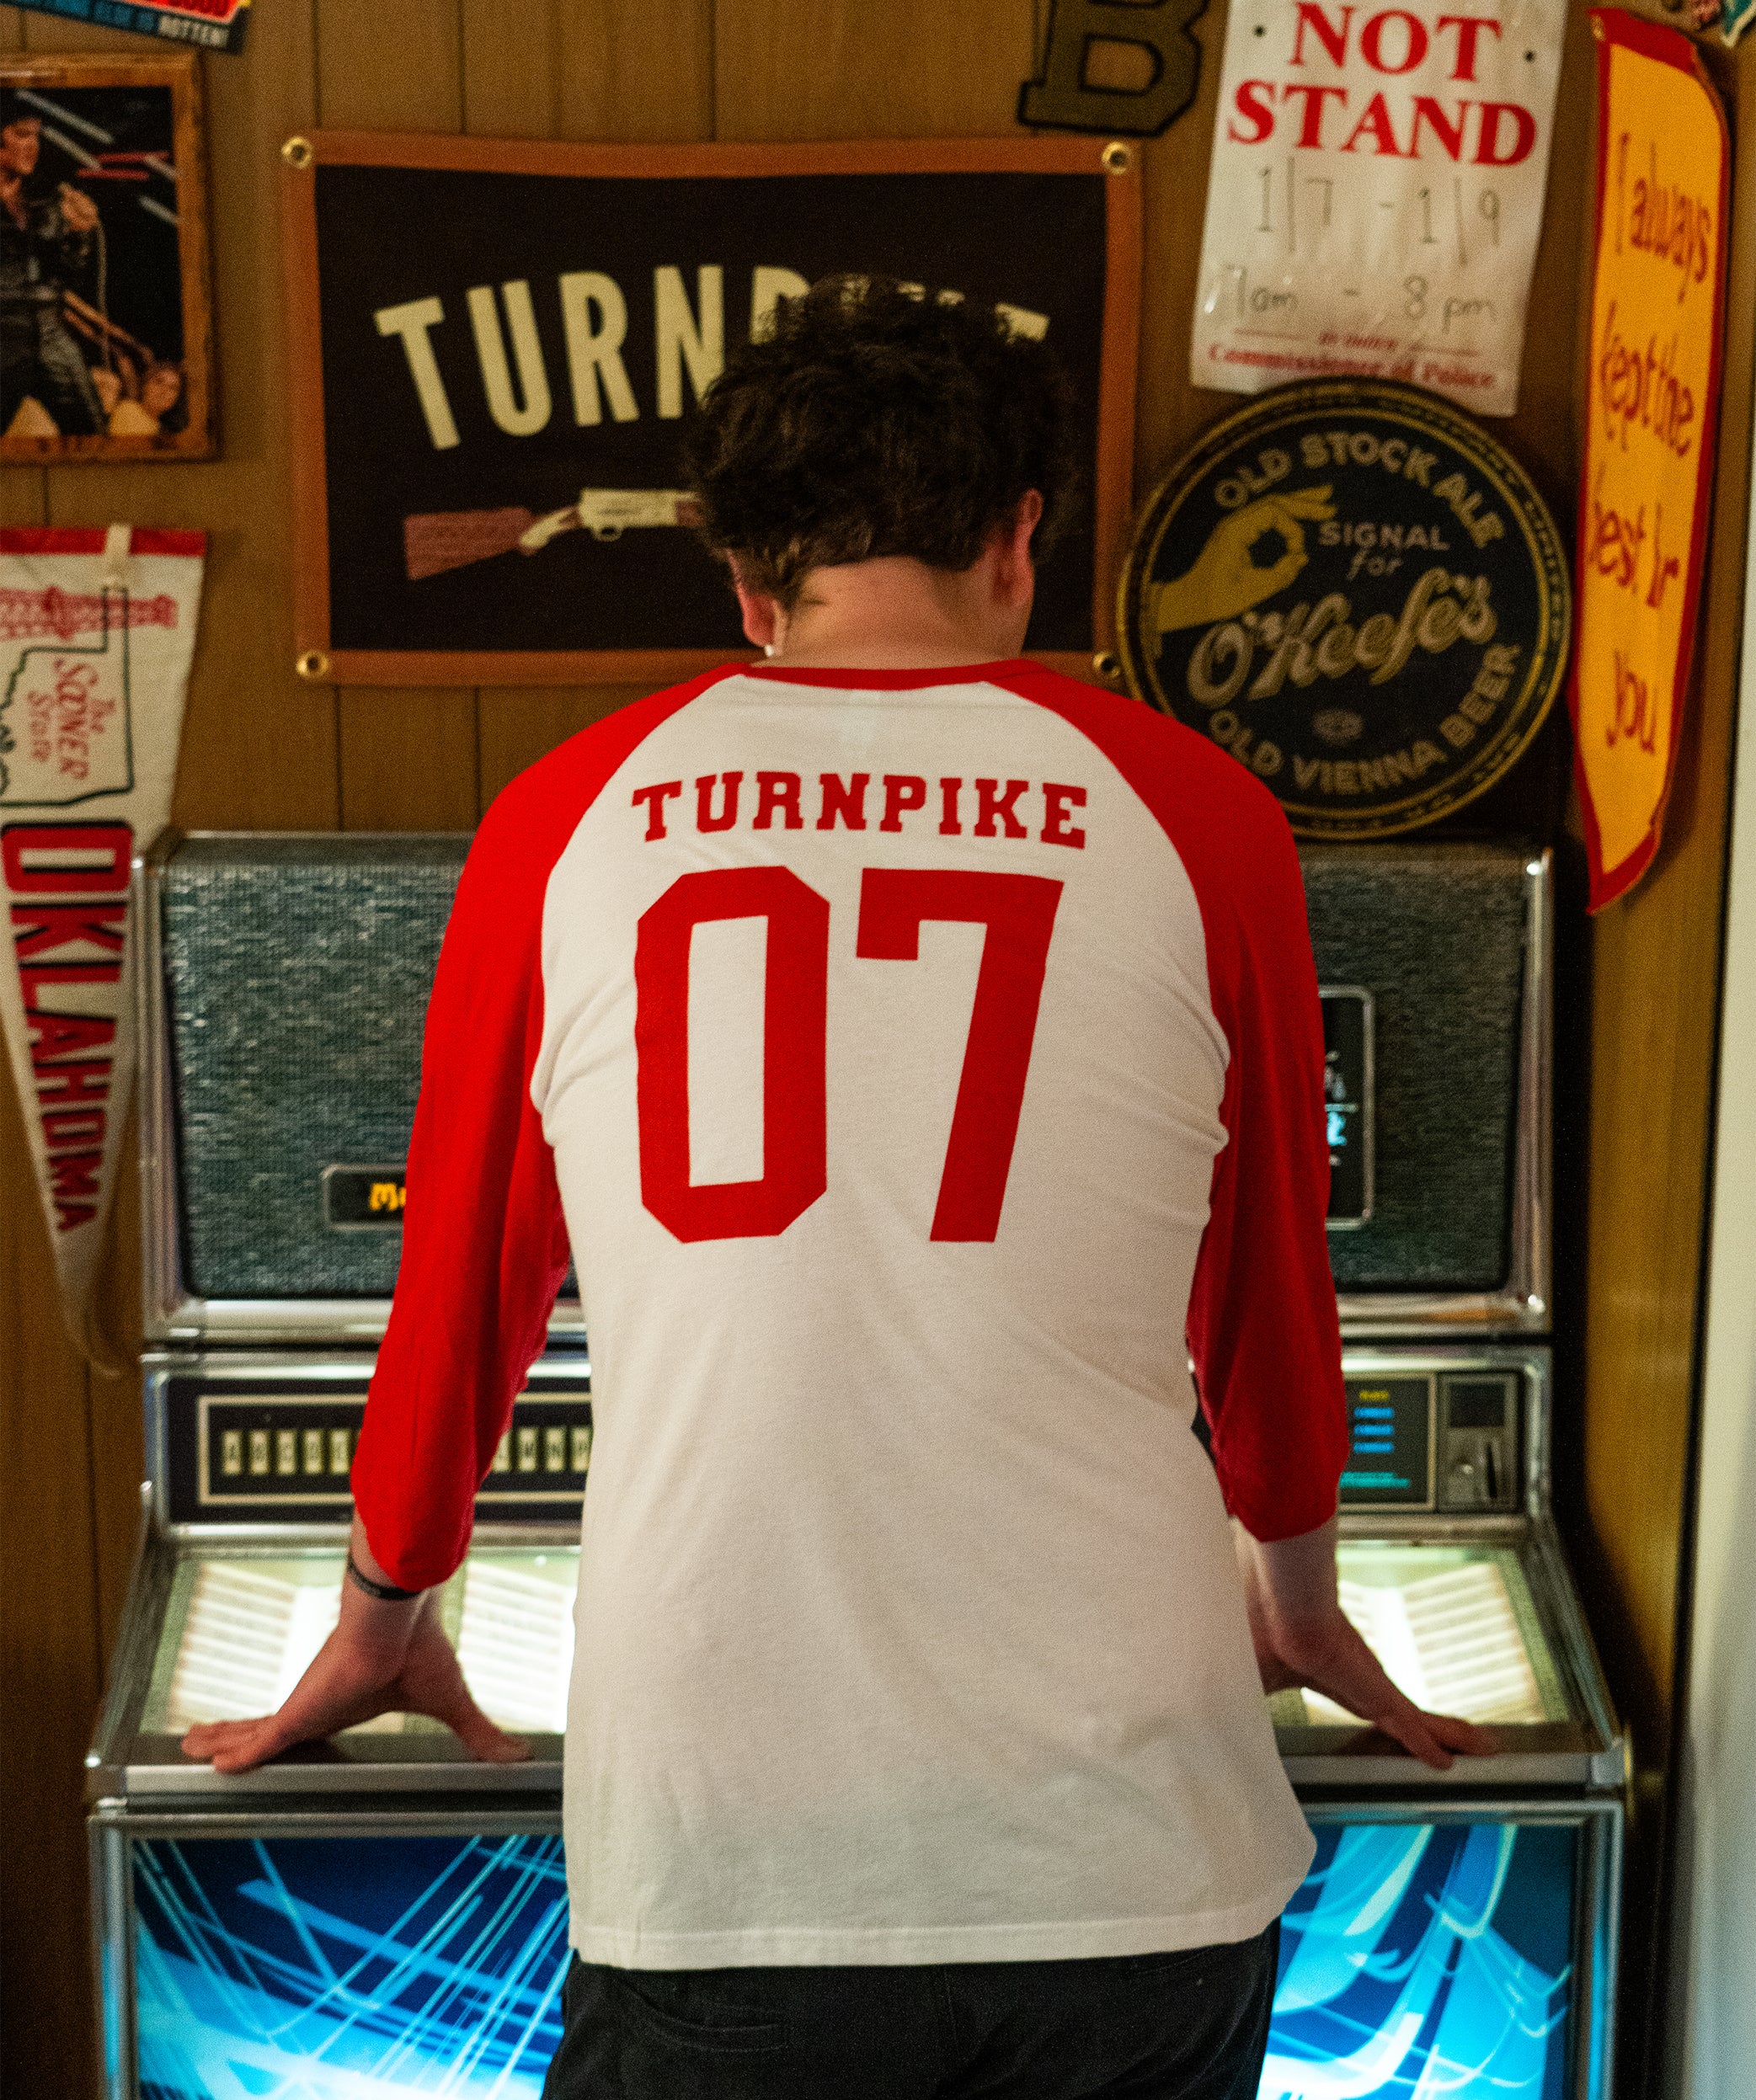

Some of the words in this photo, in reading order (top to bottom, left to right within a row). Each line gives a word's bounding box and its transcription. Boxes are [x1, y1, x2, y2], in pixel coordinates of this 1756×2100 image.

[1289, 1, 1502, 82] NOT
[1227, 79, 1537, 167] STAND
[1630, 141, 1712, 305] always
[1214, 449, 1292, 508] OLD
[1300, 430, 1439, 488] STOCK
[1432, 472, 1504, 548] ALE
[1320, 520, 1450, 552] SIGNAL
[1348, 547, 1404, 582] for
[1209, 709, 1284, 776] OLD
[1293, 739, 1448, 795] VIENNA
[1438, 644, 1521, 749] BEER
[632, 770, 1087, 850] TURNPIKE
[2, 820, 133, 1232] OKLAHOMA
[633, 865, 1065, 1245] 07
